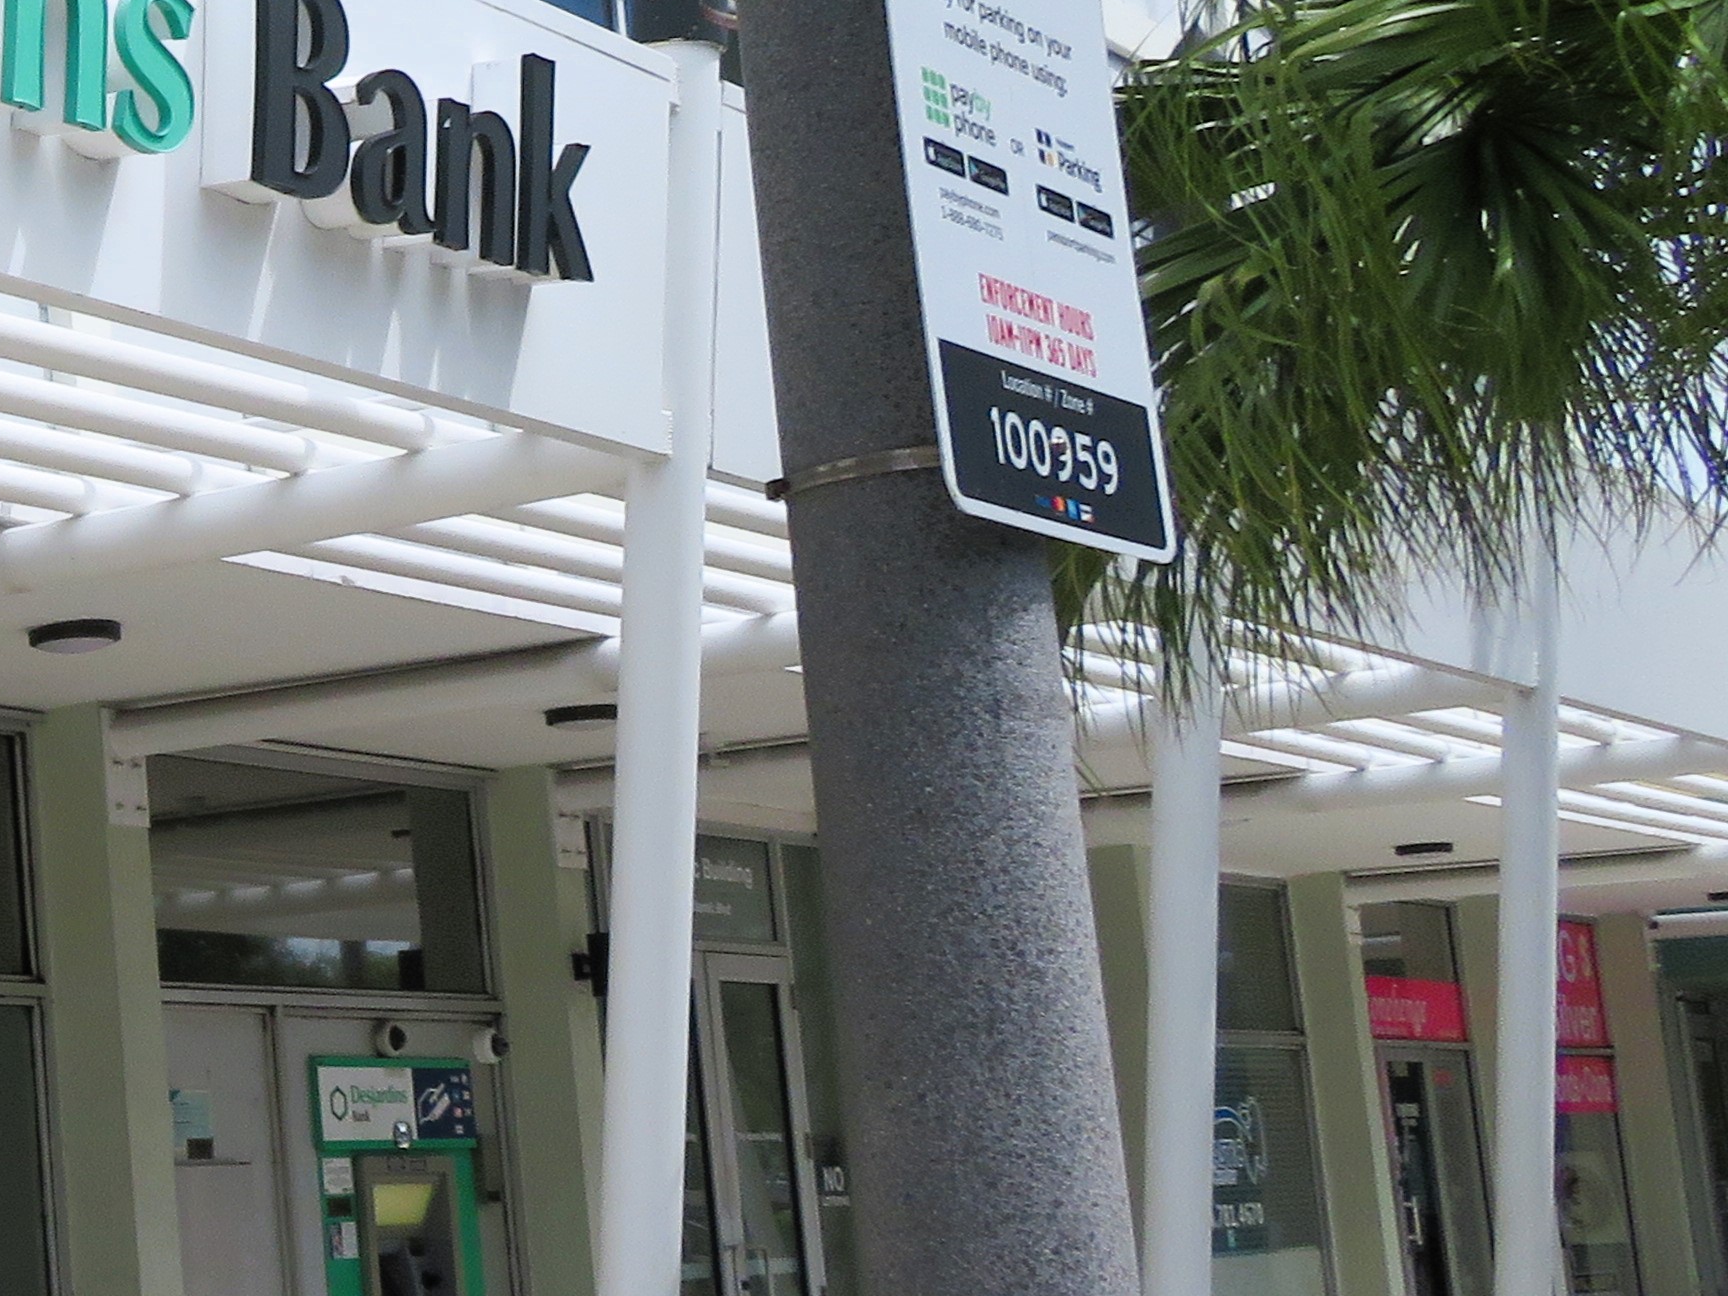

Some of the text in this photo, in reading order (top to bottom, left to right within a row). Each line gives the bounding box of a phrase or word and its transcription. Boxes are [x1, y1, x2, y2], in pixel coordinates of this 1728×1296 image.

[944, 22, 987, 56] mobile
[990, 42, 1029, 75] phone
[978, 3, 1025, 44] parking
[1028, 27, 1042, 46] on
[1045, 35, 1072, 60] your
[953, 105, 996, 146] phone
[1010, 139, 1024, 155] OR
[1057, 151, 1102, 193] Parking
[979, 273, 1094, 341] ENFORCEMENT HOURS
[1045, 334, 1065, 367] 365
[1068, 342, 1096, 378] DAYS
[1001, 370, 1044, 399] Location
[1044, 385, 1053, 402] #
[1060, 389, 1086, 414] Zone
[1085, 398, 1094, 415] #
[351, 1084, 407, 1107] Desjardins
[822, 1166, 845, 1191] NO
